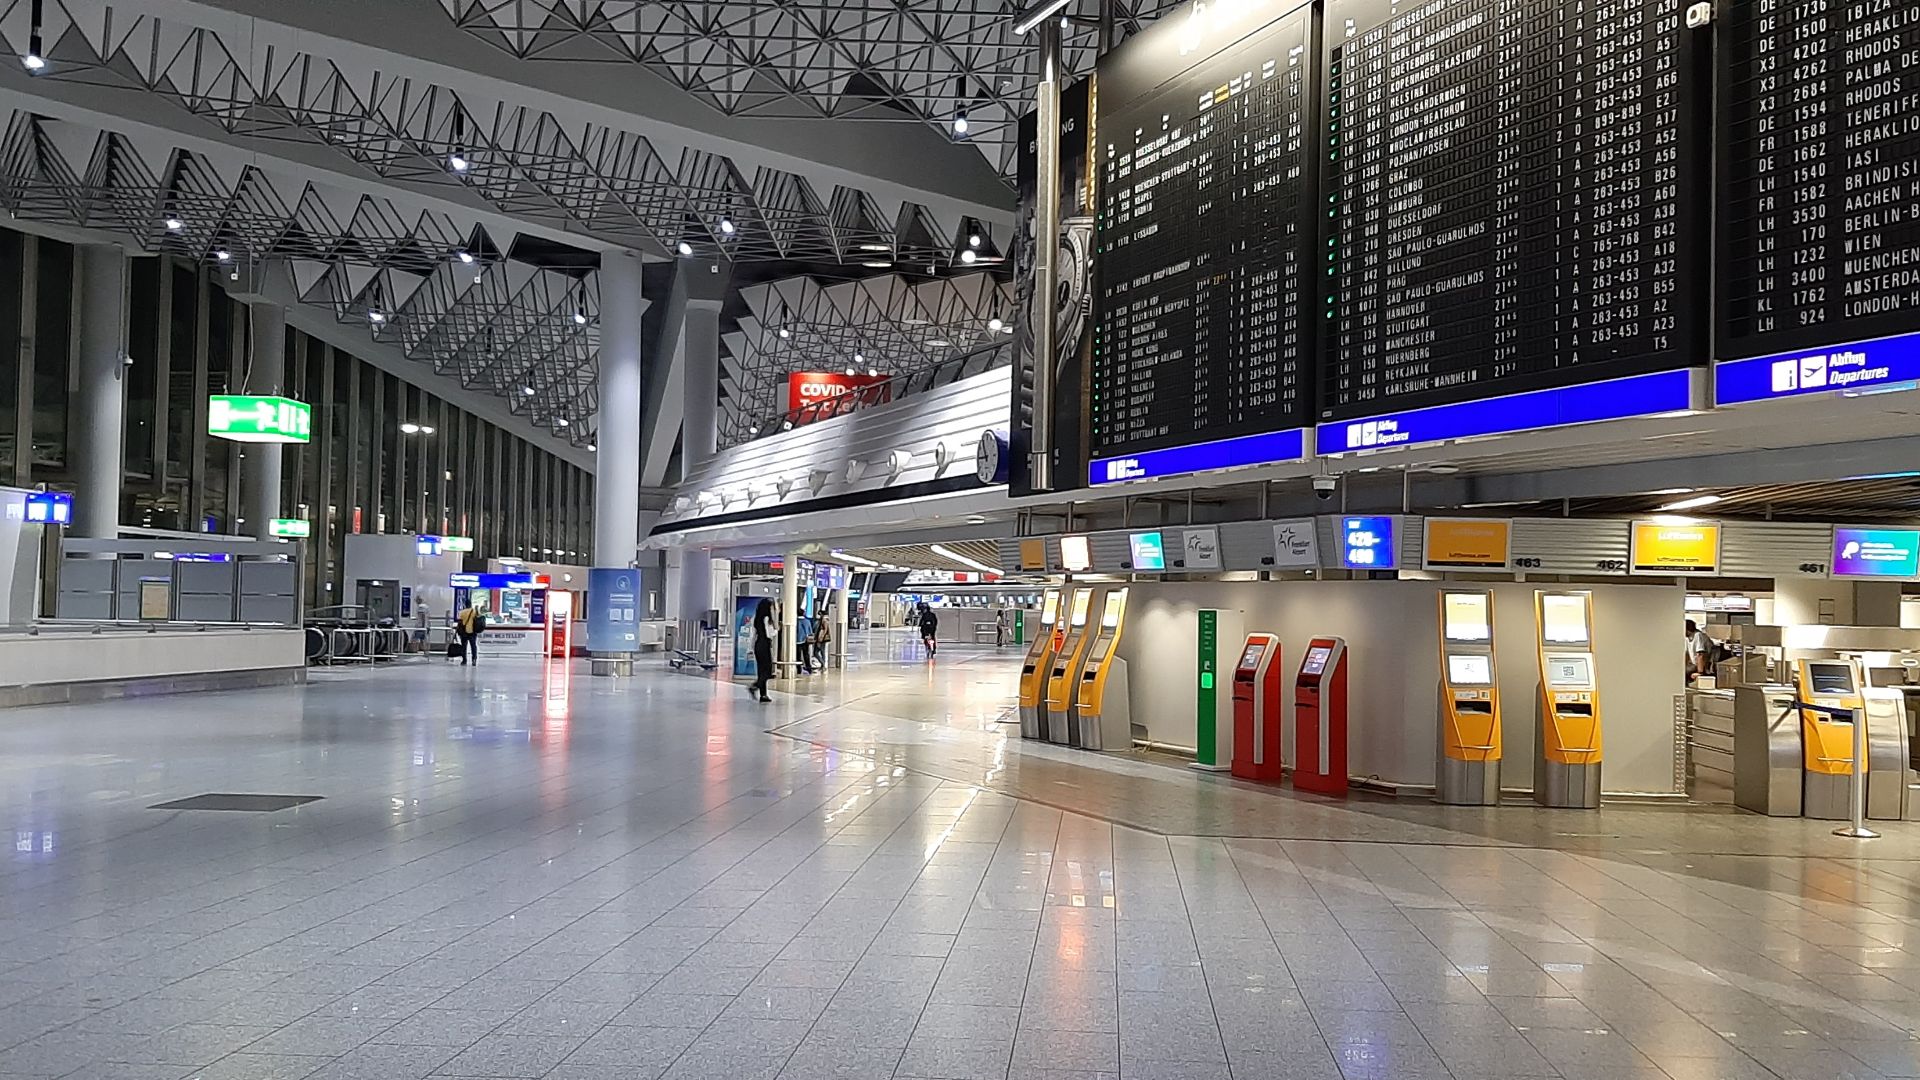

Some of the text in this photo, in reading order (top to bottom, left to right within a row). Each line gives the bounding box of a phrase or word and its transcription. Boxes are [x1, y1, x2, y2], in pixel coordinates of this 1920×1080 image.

[1595, 28, 1641, 58] 263-453
[1656, 13, 1677, 34] B20
[1596, 9, 1642, 40] 263-453
[1656, 0, 1677, 16] A30
[1760, 0, 1826, 33] DE 1736
[1760, 0, 1890, 53] DE 1500 IBIZA
[1595, 46, 1641, 76] 263-453
[1656, 35, 1670, 53] A5
[1760, 6, 1919, 73] X3 4202 HERAKLIO
[1595, 64, 1641, 94] 263-453
[1656, 54, 1670, 71] A3
[1759, 50, 1918, 112] X3 2684 PALMA DE
[1760, 34, 1899, 93] X3 4262 RHODOS
[1595, 83, 1641, 112] 263-453
[1656, 70, 1677, 90] A66
[1595, 101, 1641, 129] 899-899
[1656, 91, 1669, 108] E2
[1759, 77, 1900, 132] DE 1594 RHODOS
[1594, 119, 1641, 147] 263-453
[1655, 107, 1676, 127] A17
[1760, 94, 1918, 152] FR 1588 TENERIFF
[1595, 138, 1640, 165] 263-453
[1655, 126, 1676, 145] A52
[1759, 115, 1919, 172] DE 1662 HERAKLIO
[1593, 175, 1640, 201] 263-453
[1655, 164, 1675, 183] B26
[1594, 156, 1640, 183] 263-453
[1655, 145, 1676, 164] A56
[1759, 148, 1878, 192] LH 1540 IASI
[1593, 193, 1639, 218] 263-453
[1654, 183, 1675, 202] A60
[1759, 160, 1917, 212] FR 1582 BRINDISI
[1593, 212, 1639, 236] 263-453
[1654, 202, 1675, 220] A38
[1759, 215, 1774, 232] LH
[1793, 203, 1825, 224] 3530
[1845, 185, 1900, 212] AACHEN
[1759, 203, 1919, 251] LH 170 BERLIN-B
[1593, 249, 1639, 272] 263-453
[1654, 240, 1675, 258] A18
[1594, 230, 1639, 254] 765-768
[1654, 221, 1674, 239] B42
[1758, 233, 1880, 271] LH 1232 WIEN
[1592, 267, 1638, 290] 263-453
[1653, 259, 1674, 276] A32
[1758, 247, 1919, 291] LH 3400 MUENCHEN
[1592, 286, 1638, 308] 263-453
[1654, 278, 1674, 295] B55
[1758, 269, 1919, 311] KL 1762 AMSTERDA
[1592, 304, 1638, 325] 263-453
[1653, 298, 1666, 313] A2
[1592, 323, 1638, 343] 263-453
[1653, 316, 1674, 332] A23
[1758, 291, 1918, 331] LH 924 LONDON-H
[1654, 336, 1667, 350] T5
[1829, 351, 1866, 368] Abflug
[1829, 367, 1889, 386] Departures
[1515, 557, 1541, 568] 463
[1597, 559, 1625, 570] 462
[1799, 563, 1825, 573] 461
